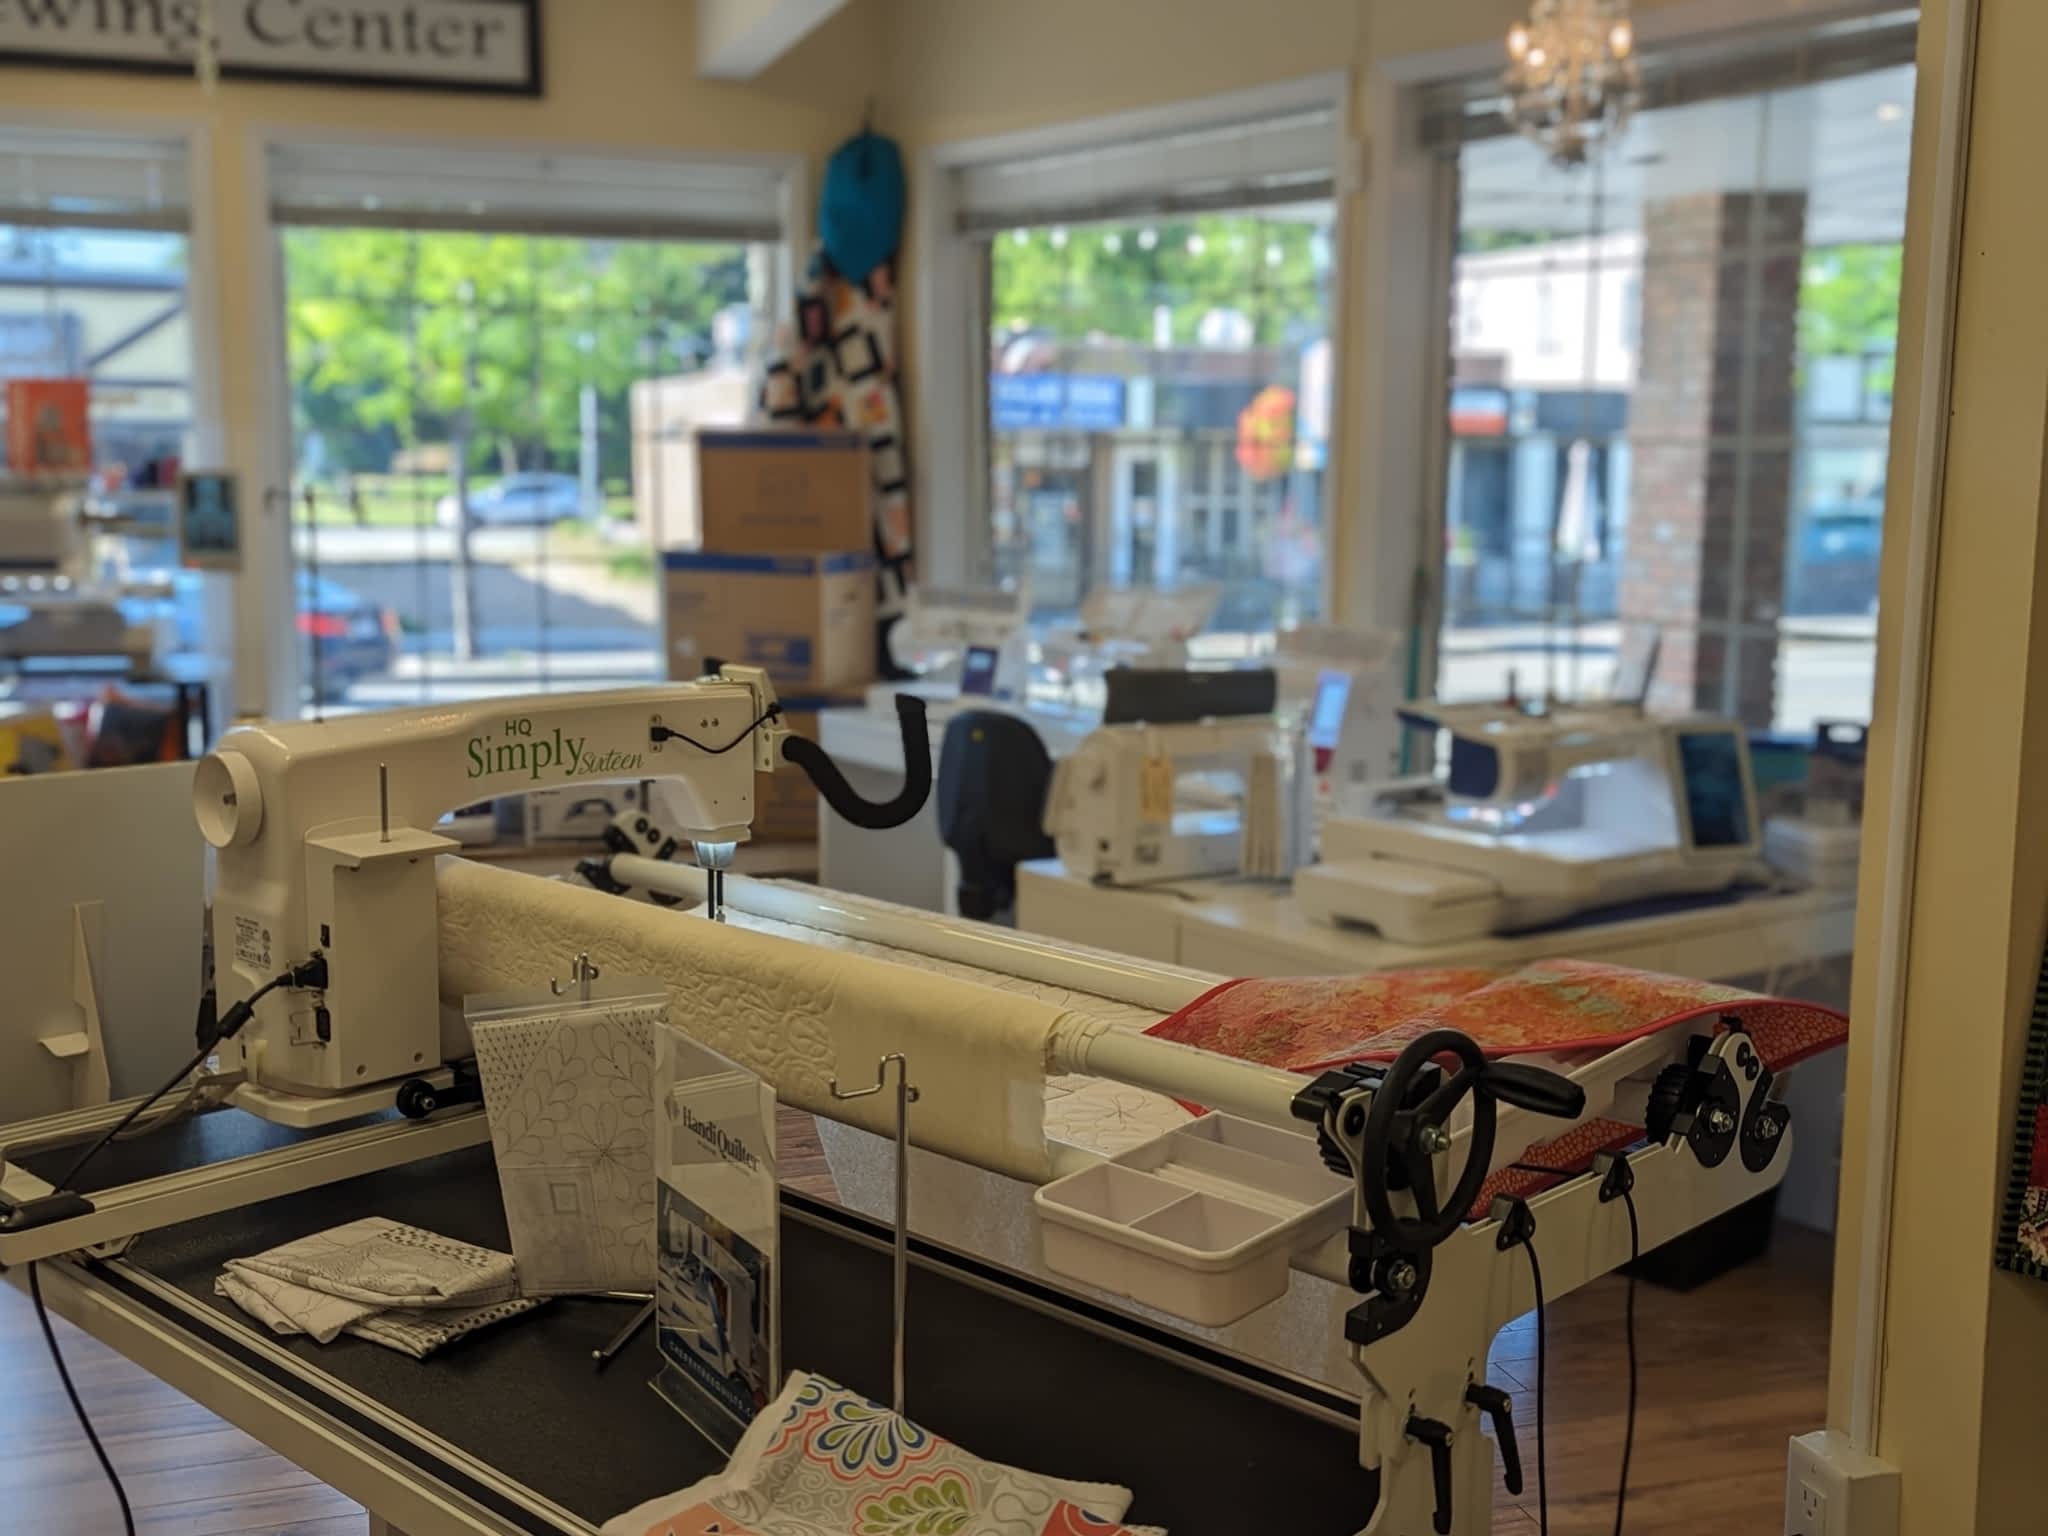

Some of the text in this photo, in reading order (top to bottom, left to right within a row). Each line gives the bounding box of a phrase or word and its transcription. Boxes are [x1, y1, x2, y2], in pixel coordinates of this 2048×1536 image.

[243, 0, 505, 60] Center
[467, 727, 646, 780] Simply Sixteen
[505, 719, 532, 736] HQ
